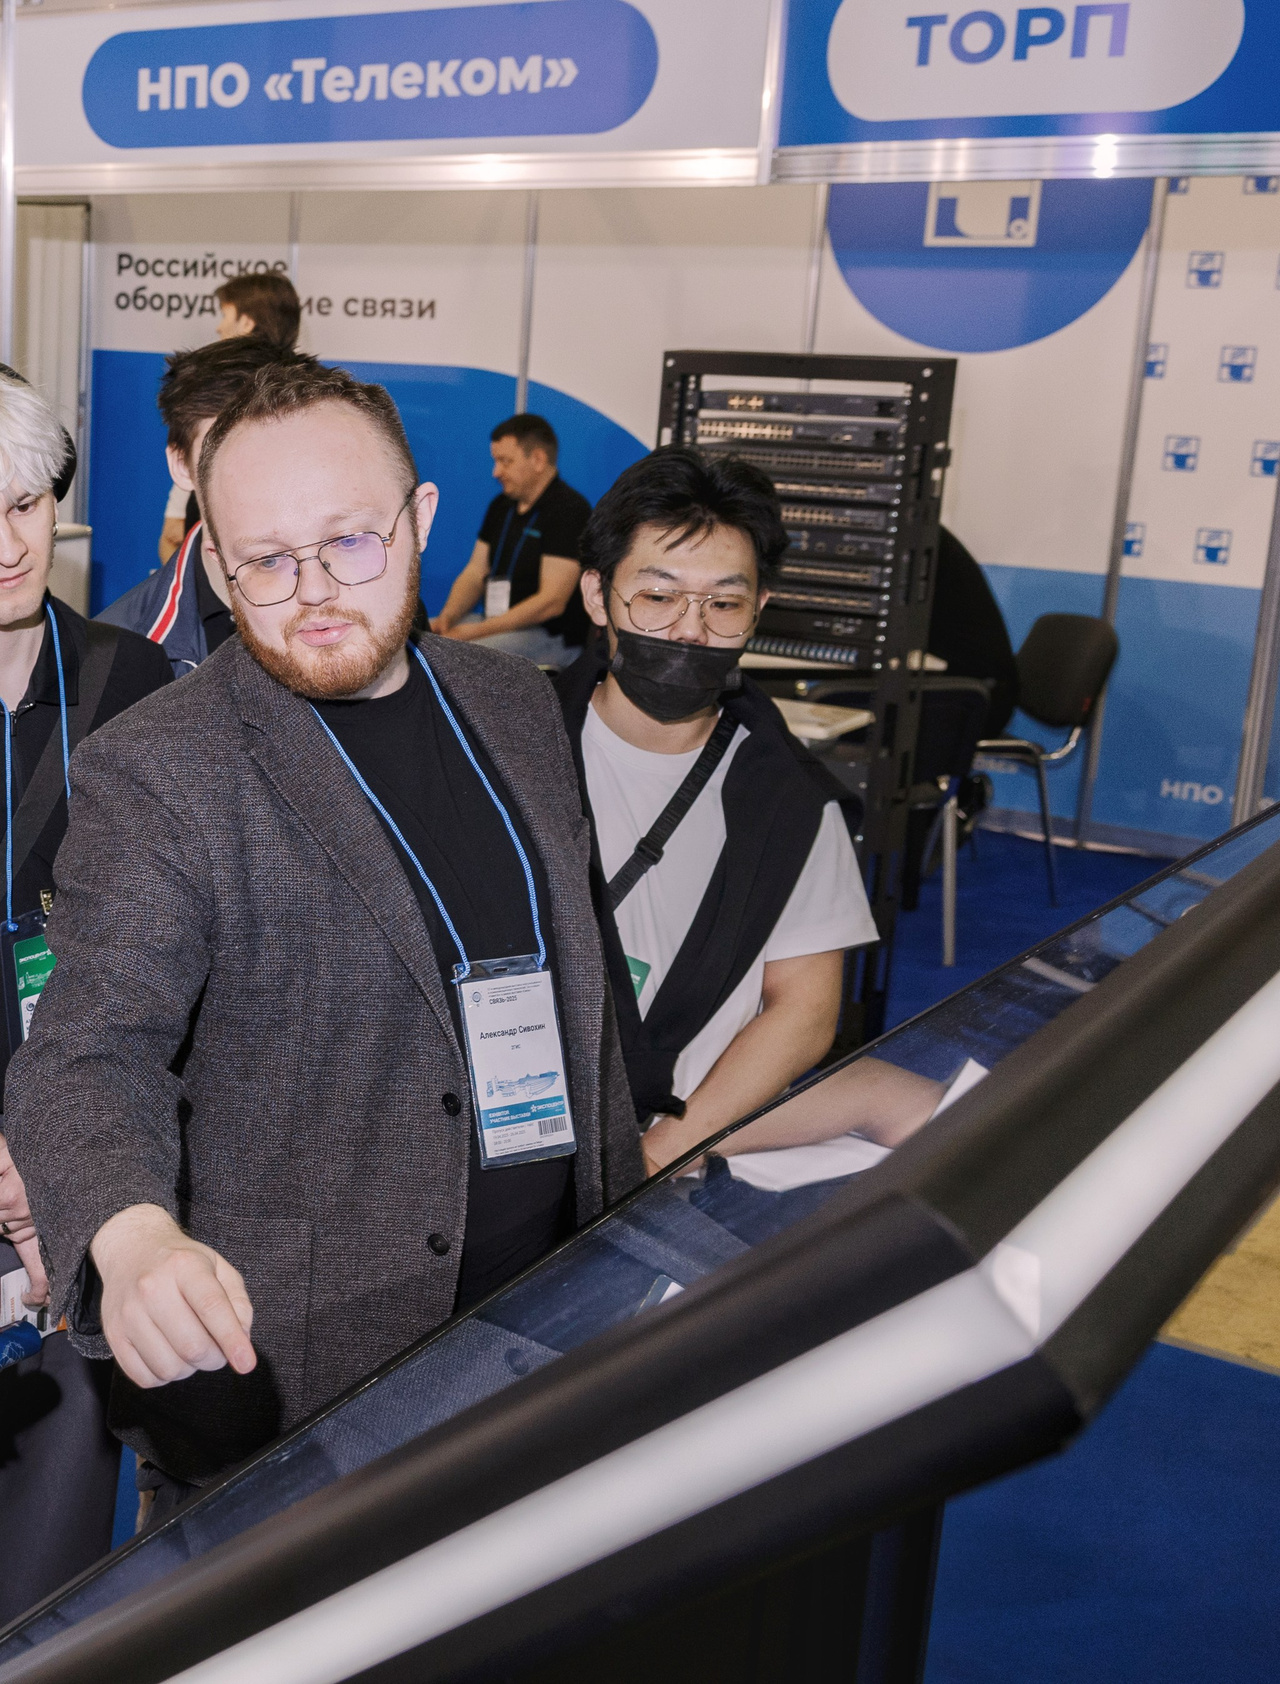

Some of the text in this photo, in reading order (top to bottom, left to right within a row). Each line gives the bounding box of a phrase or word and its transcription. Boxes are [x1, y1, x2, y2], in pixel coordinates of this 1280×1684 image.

[905, 2, 1131, 67] ТОРП
[137, 54, 579, 111] НПО «Телеком»
[117, 252, 288, 279] Российское
[343, 296, 437, 320] связи
[1160, 778, 1224, 805] НПО
[479, 1027, 518, 1040] Александр
